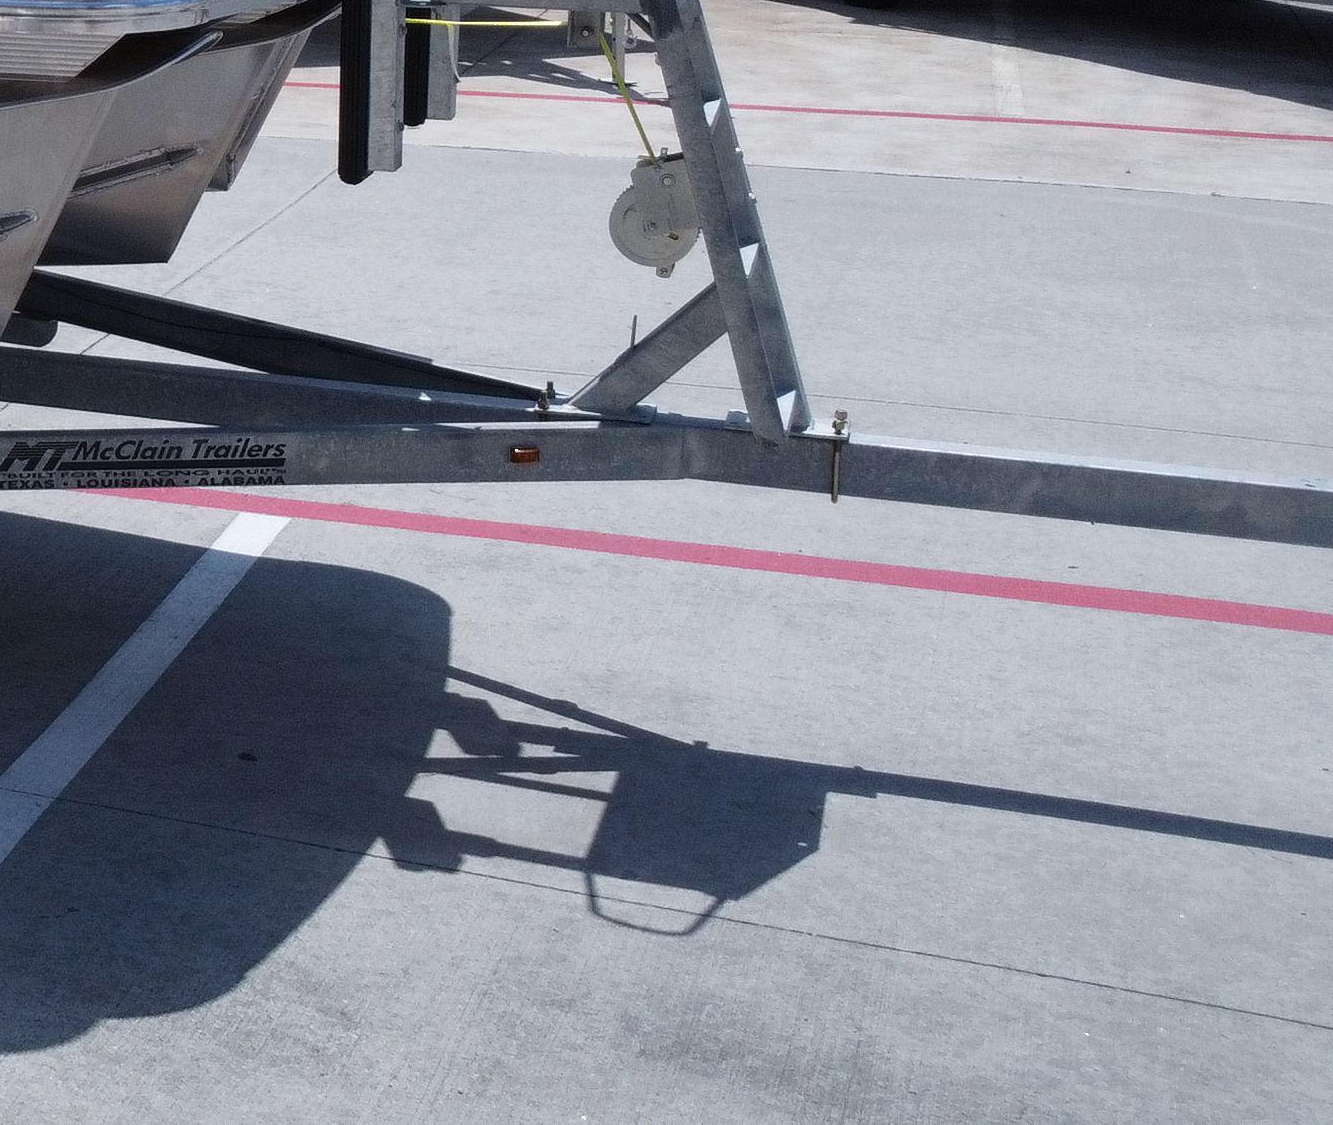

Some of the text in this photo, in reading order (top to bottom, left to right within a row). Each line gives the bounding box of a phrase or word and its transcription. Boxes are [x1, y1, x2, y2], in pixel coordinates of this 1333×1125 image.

[72, 440, 183, 461] McClain
[191, 438, 286, 459] Trailers
[77, 477, 175, 488] LOUISIANA
[198, 475, 285, 486] ALABAMA
